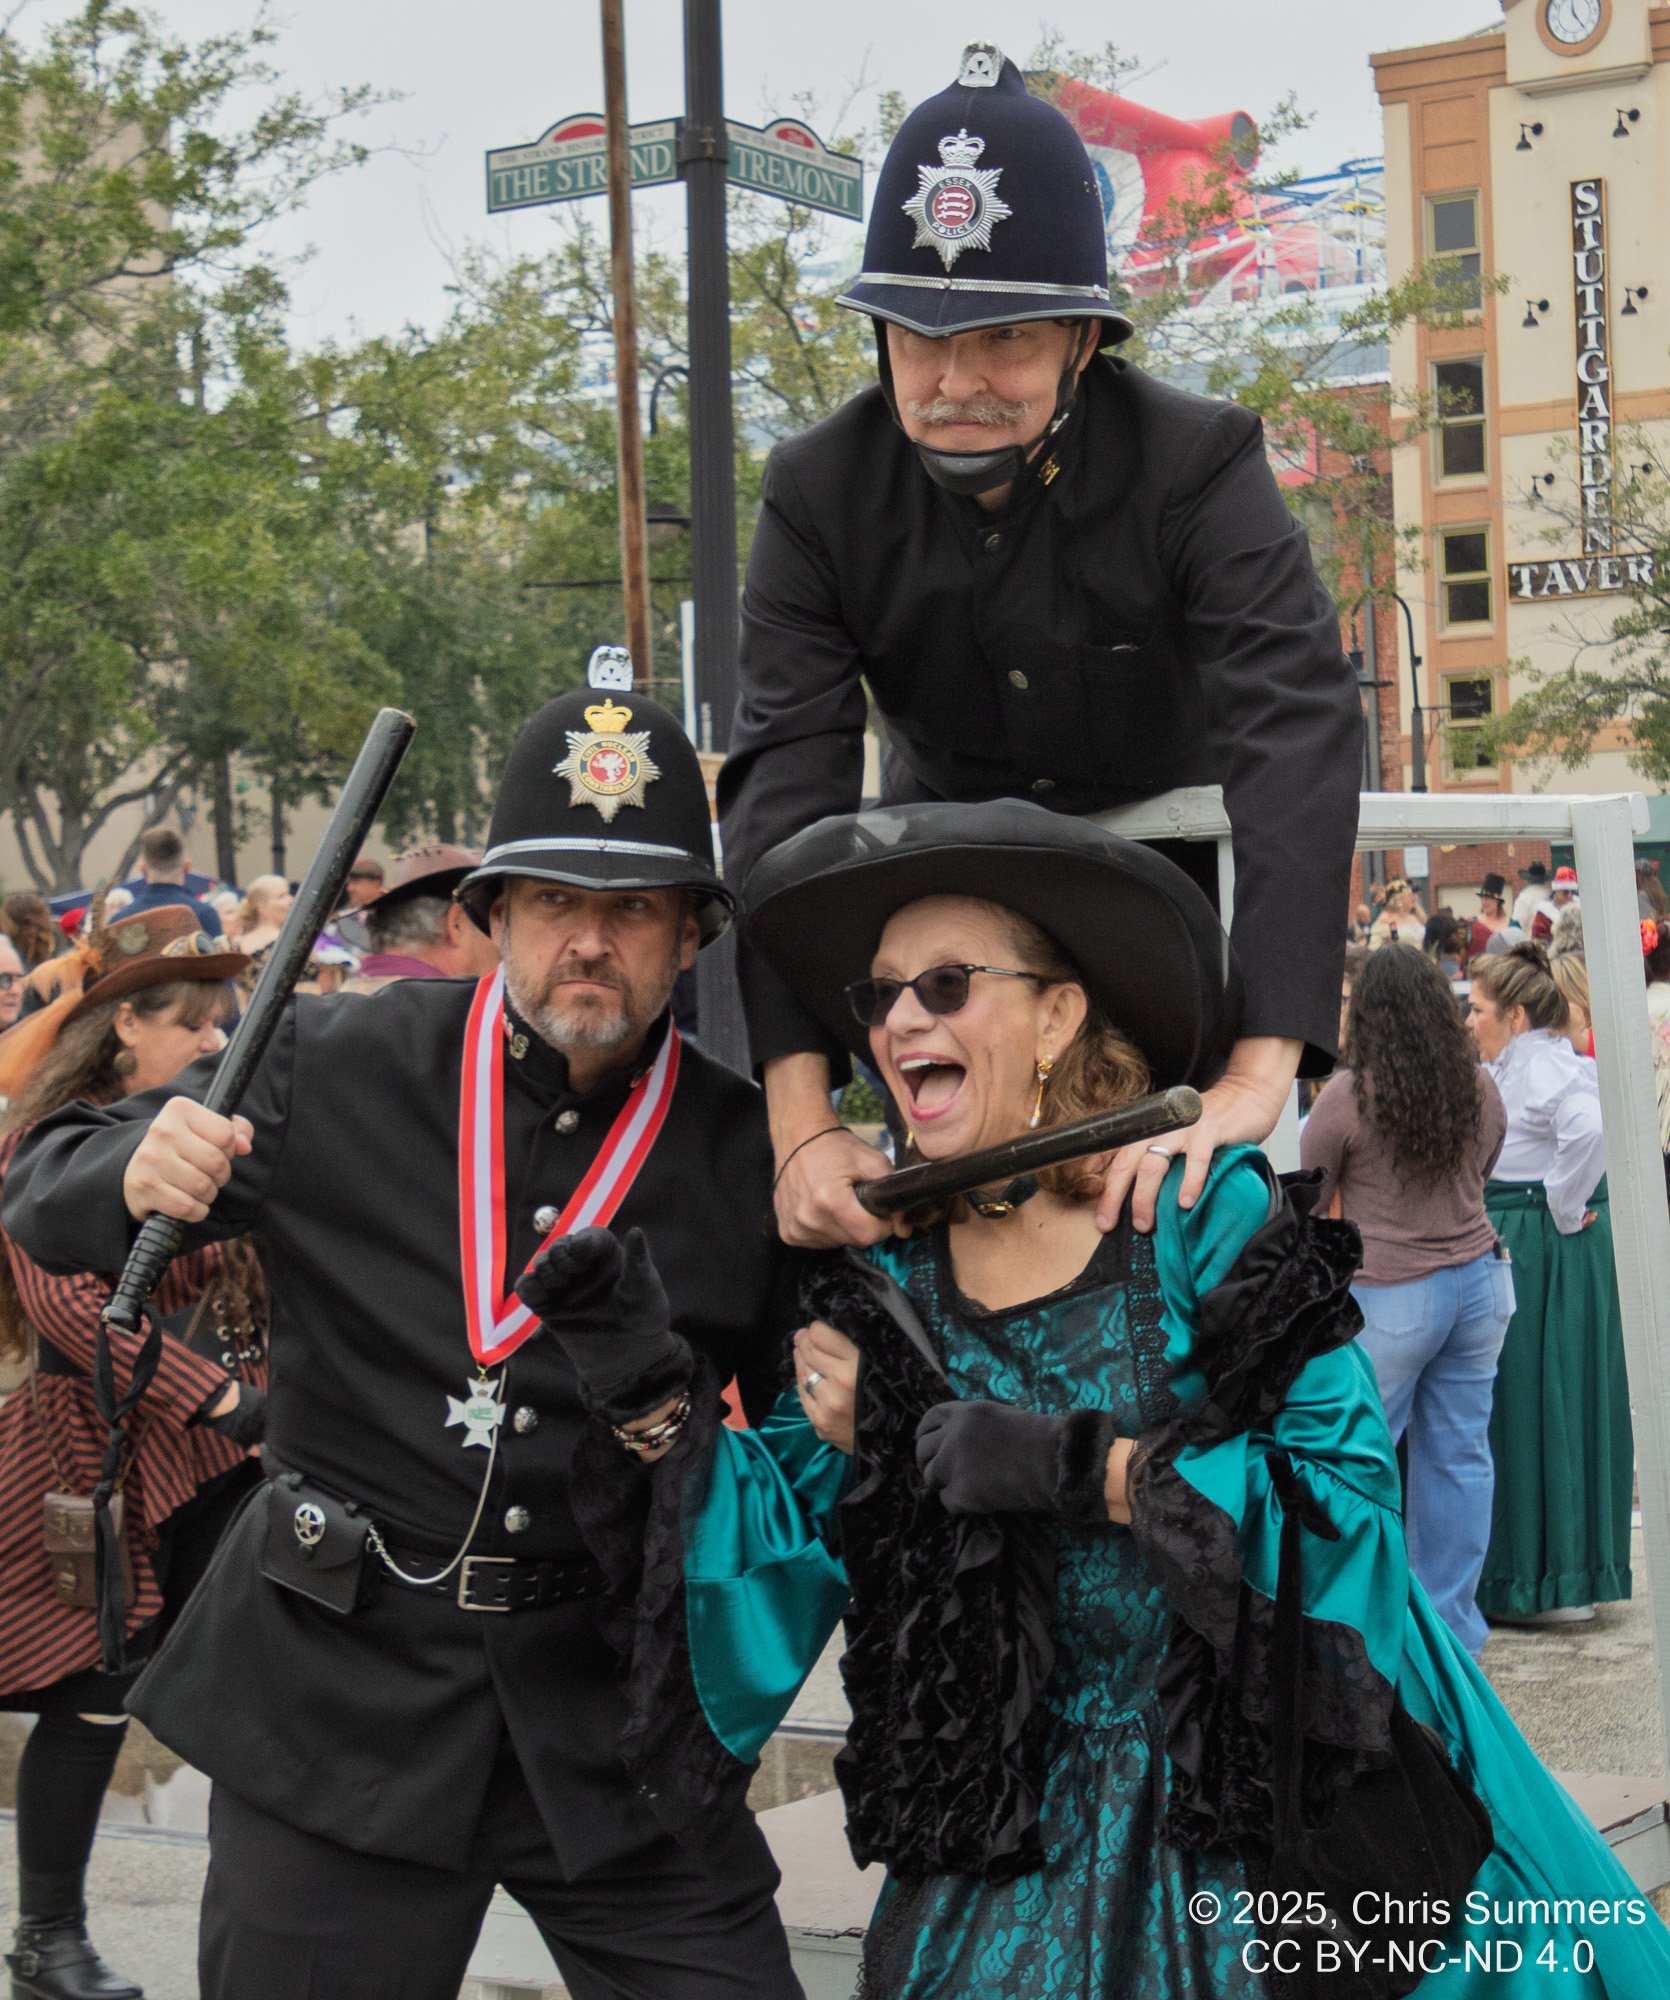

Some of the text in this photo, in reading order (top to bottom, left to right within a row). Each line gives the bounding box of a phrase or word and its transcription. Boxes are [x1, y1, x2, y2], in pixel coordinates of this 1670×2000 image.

[494, 143, 672, 201] THE STRND
[735, 145, 854, 209] TREMONT
[938, 177, 973, 190] ESSEX
[932, 221, 974, 236] POLICE
[1573, 181, 1612, 554] STUTTGARDEN
[1511, 554, 1669, 599] TAVER
